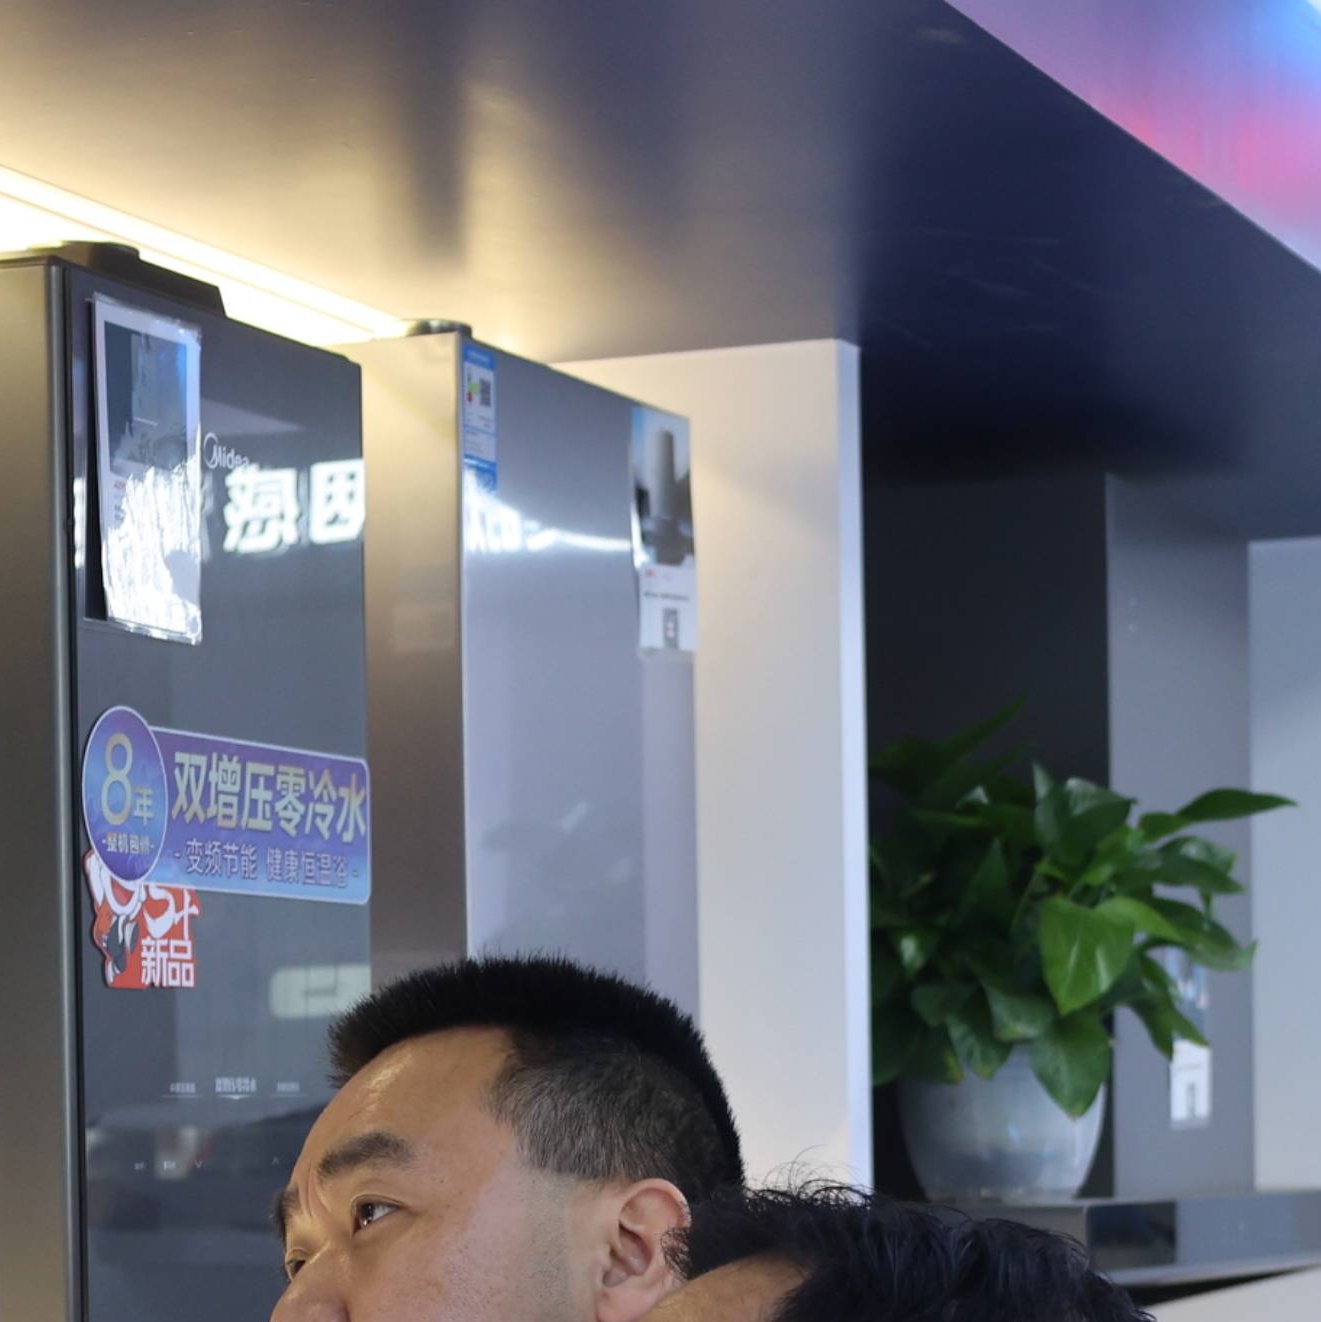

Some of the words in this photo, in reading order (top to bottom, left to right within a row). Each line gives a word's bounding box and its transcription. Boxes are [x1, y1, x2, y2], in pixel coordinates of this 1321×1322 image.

[171, 751, 367, 843] 双增压零冷水
[186, 838, 258, 881] 变频节能
[267, 847, 349, 889] 健康恒温浴
[141, 936, 195, 988] 新品
